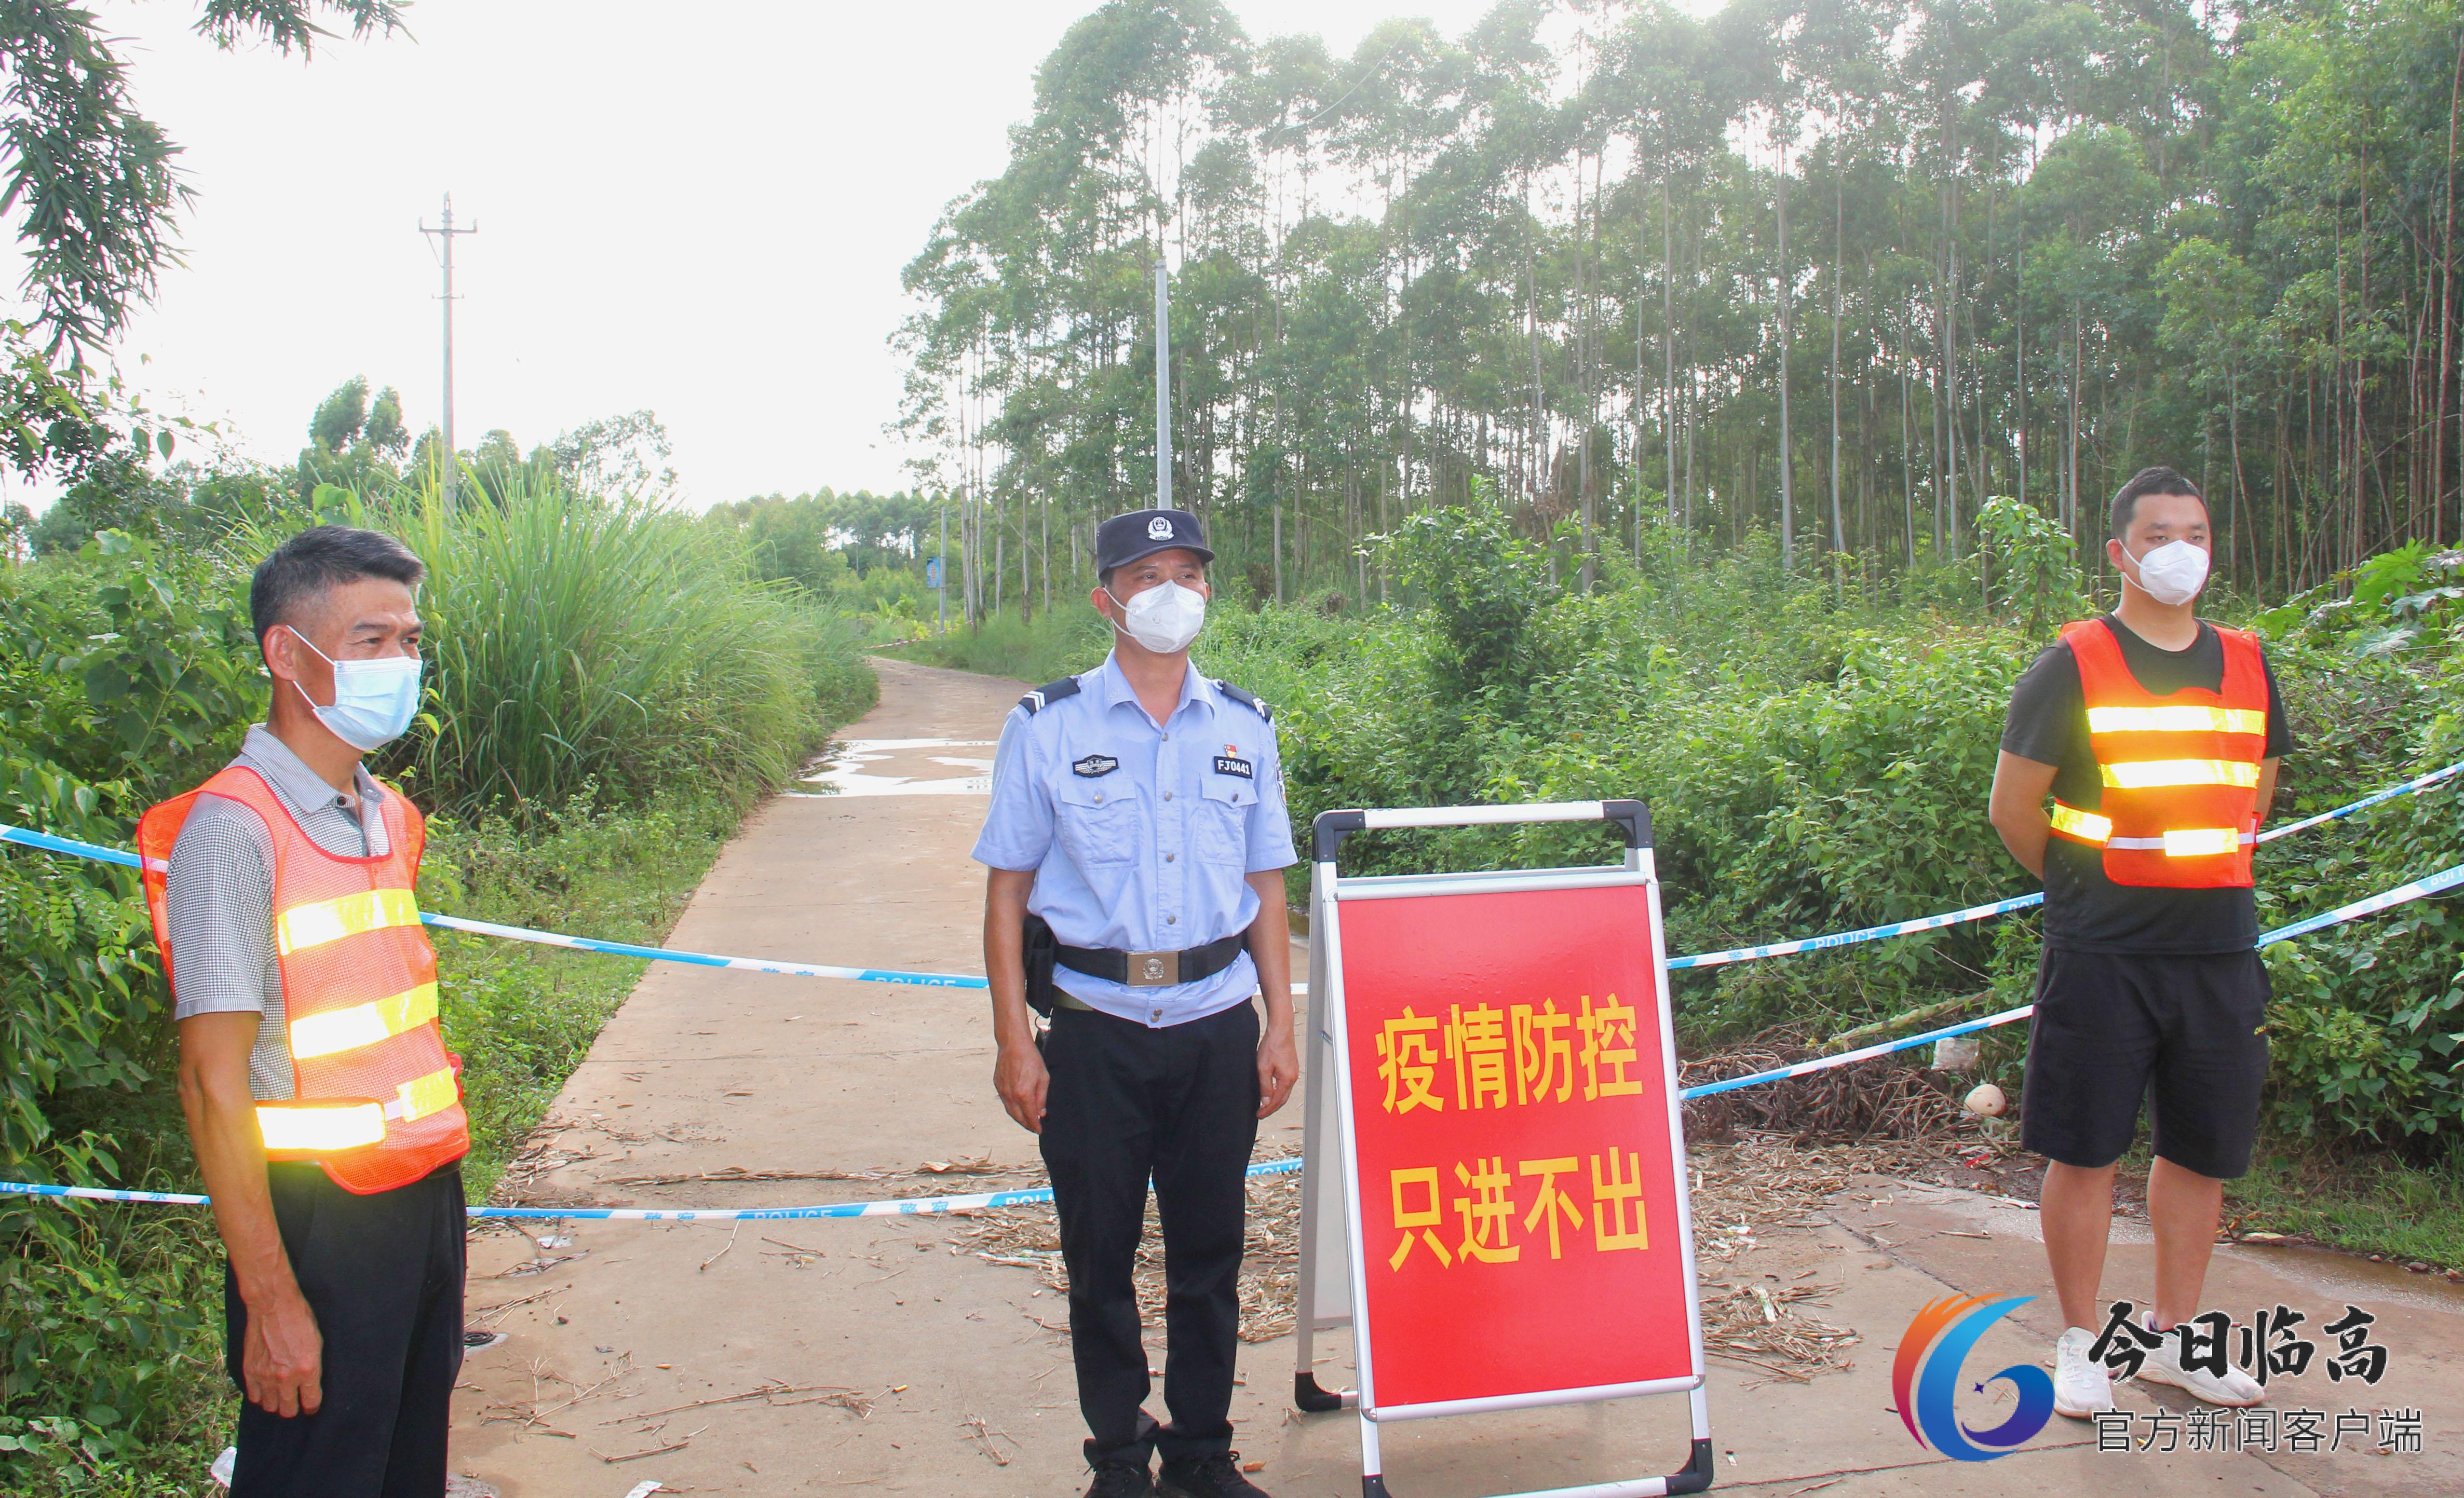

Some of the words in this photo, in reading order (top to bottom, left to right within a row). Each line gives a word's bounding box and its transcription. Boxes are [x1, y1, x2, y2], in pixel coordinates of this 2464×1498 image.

[1217, 760, 1250, 775] FJ0441
[1375, 992, 1643, 1115] 疫情防控
[1388, 1146, 1649, 1273] 只进不出
